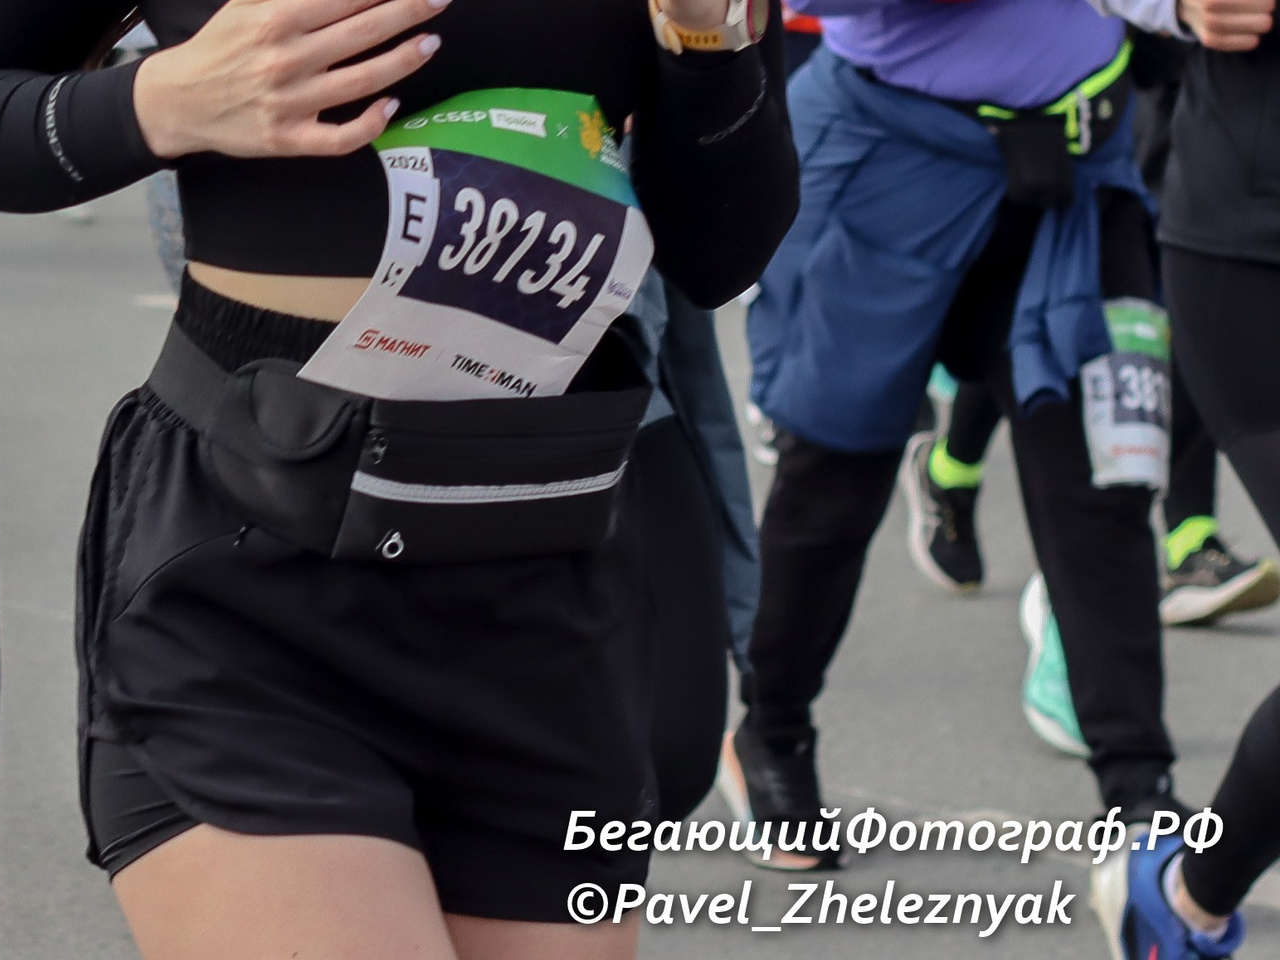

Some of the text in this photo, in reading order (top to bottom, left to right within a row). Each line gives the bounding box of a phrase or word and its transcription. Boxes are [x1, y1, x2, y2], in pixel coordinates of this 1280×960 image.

[432, 110, 487, 123] СБЕР
[386, 156, 429, 172] 2026
[401, 192, 428, 244] E
[438, 187, 606, 309] 38134
[374, 336, 432, 359] МАГНИТ
